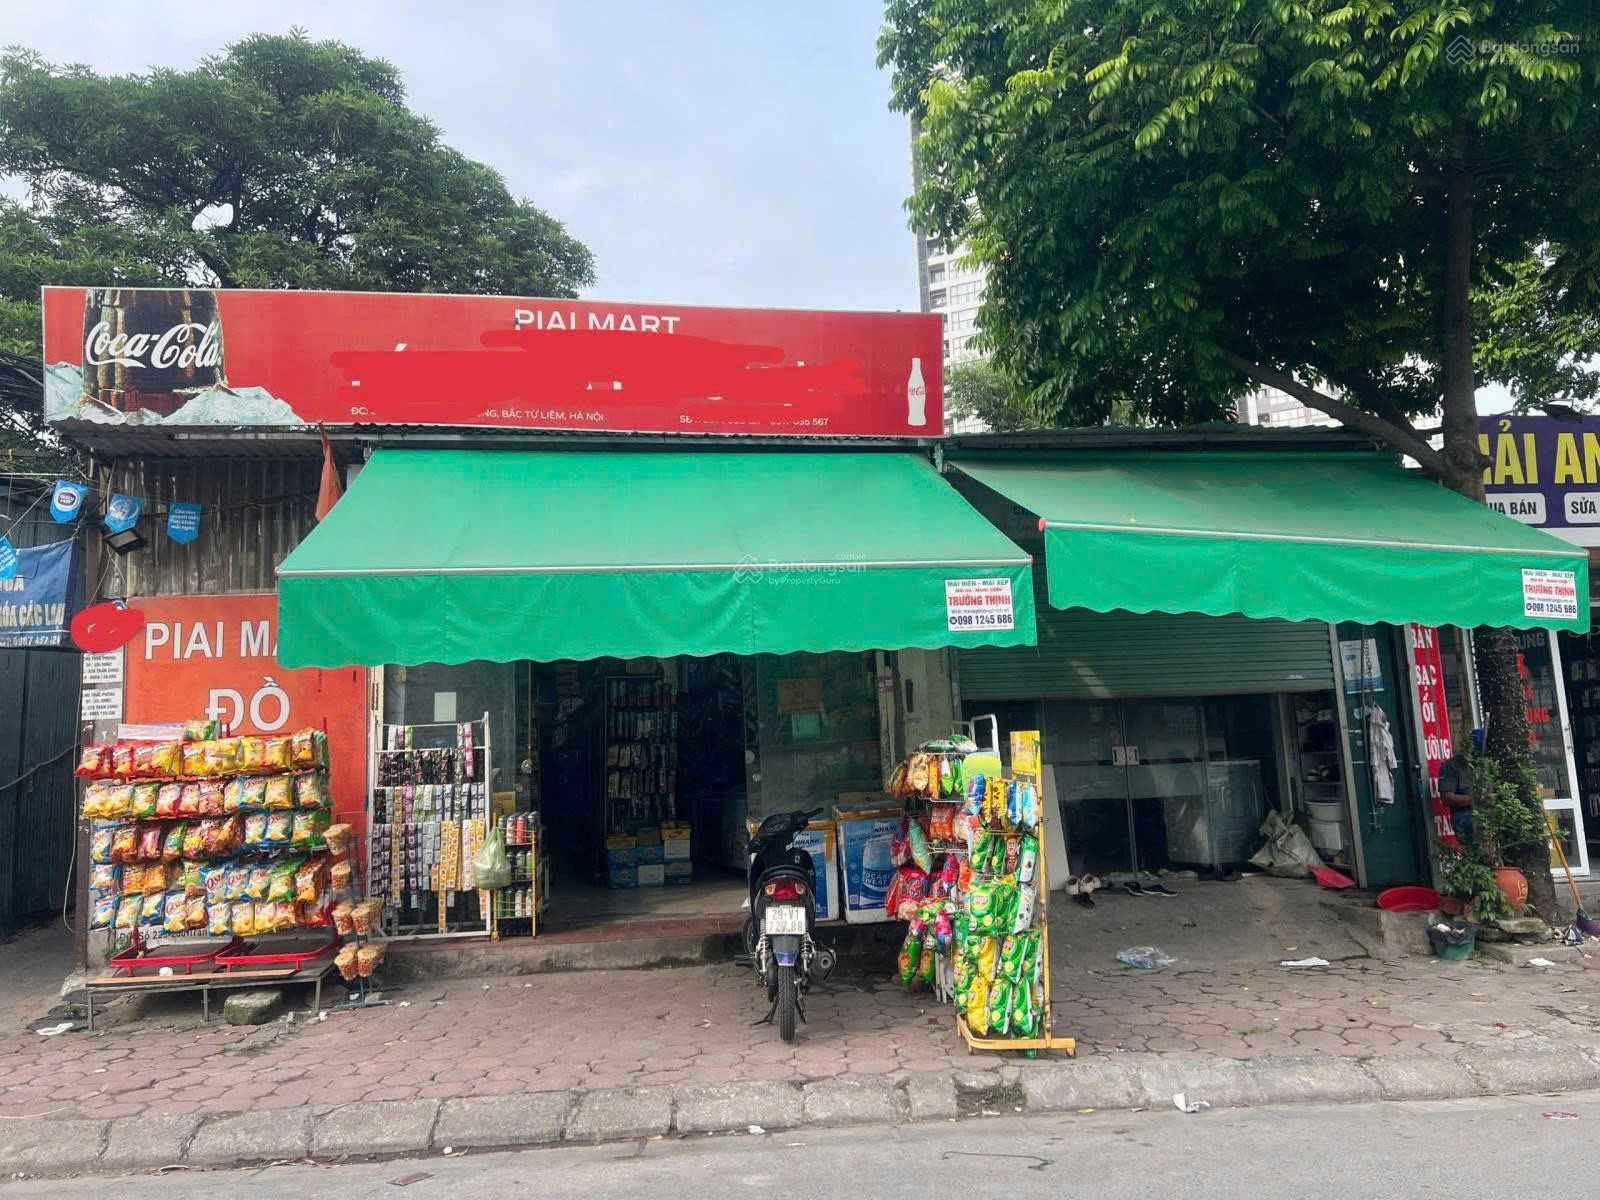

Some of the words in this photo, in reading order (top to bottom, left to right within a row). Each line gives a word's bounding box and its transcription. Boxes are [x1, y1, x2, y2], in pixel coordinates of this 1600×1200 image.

[588, 313, 681, 334] MART
[85, 321, 222, 369] Coca-Cola
[502, 409, 522, 419] BẮC
[812, 418, 829, 426] 567
[1510, 499, 1537, 515] BÁN
[1571, 496, 1597, 514] SỬA
[985, 595, 1011, 607] THỊNH
[1546, 604, 1562, 613] 1245
[19, 600, 42, 628] CÁC
[958, 616, 972, 625] 098
[975, 615, 995, 624] 1245
[997, 614, 1012, 624] 686
[144, 621, 224, 660] PIAI
